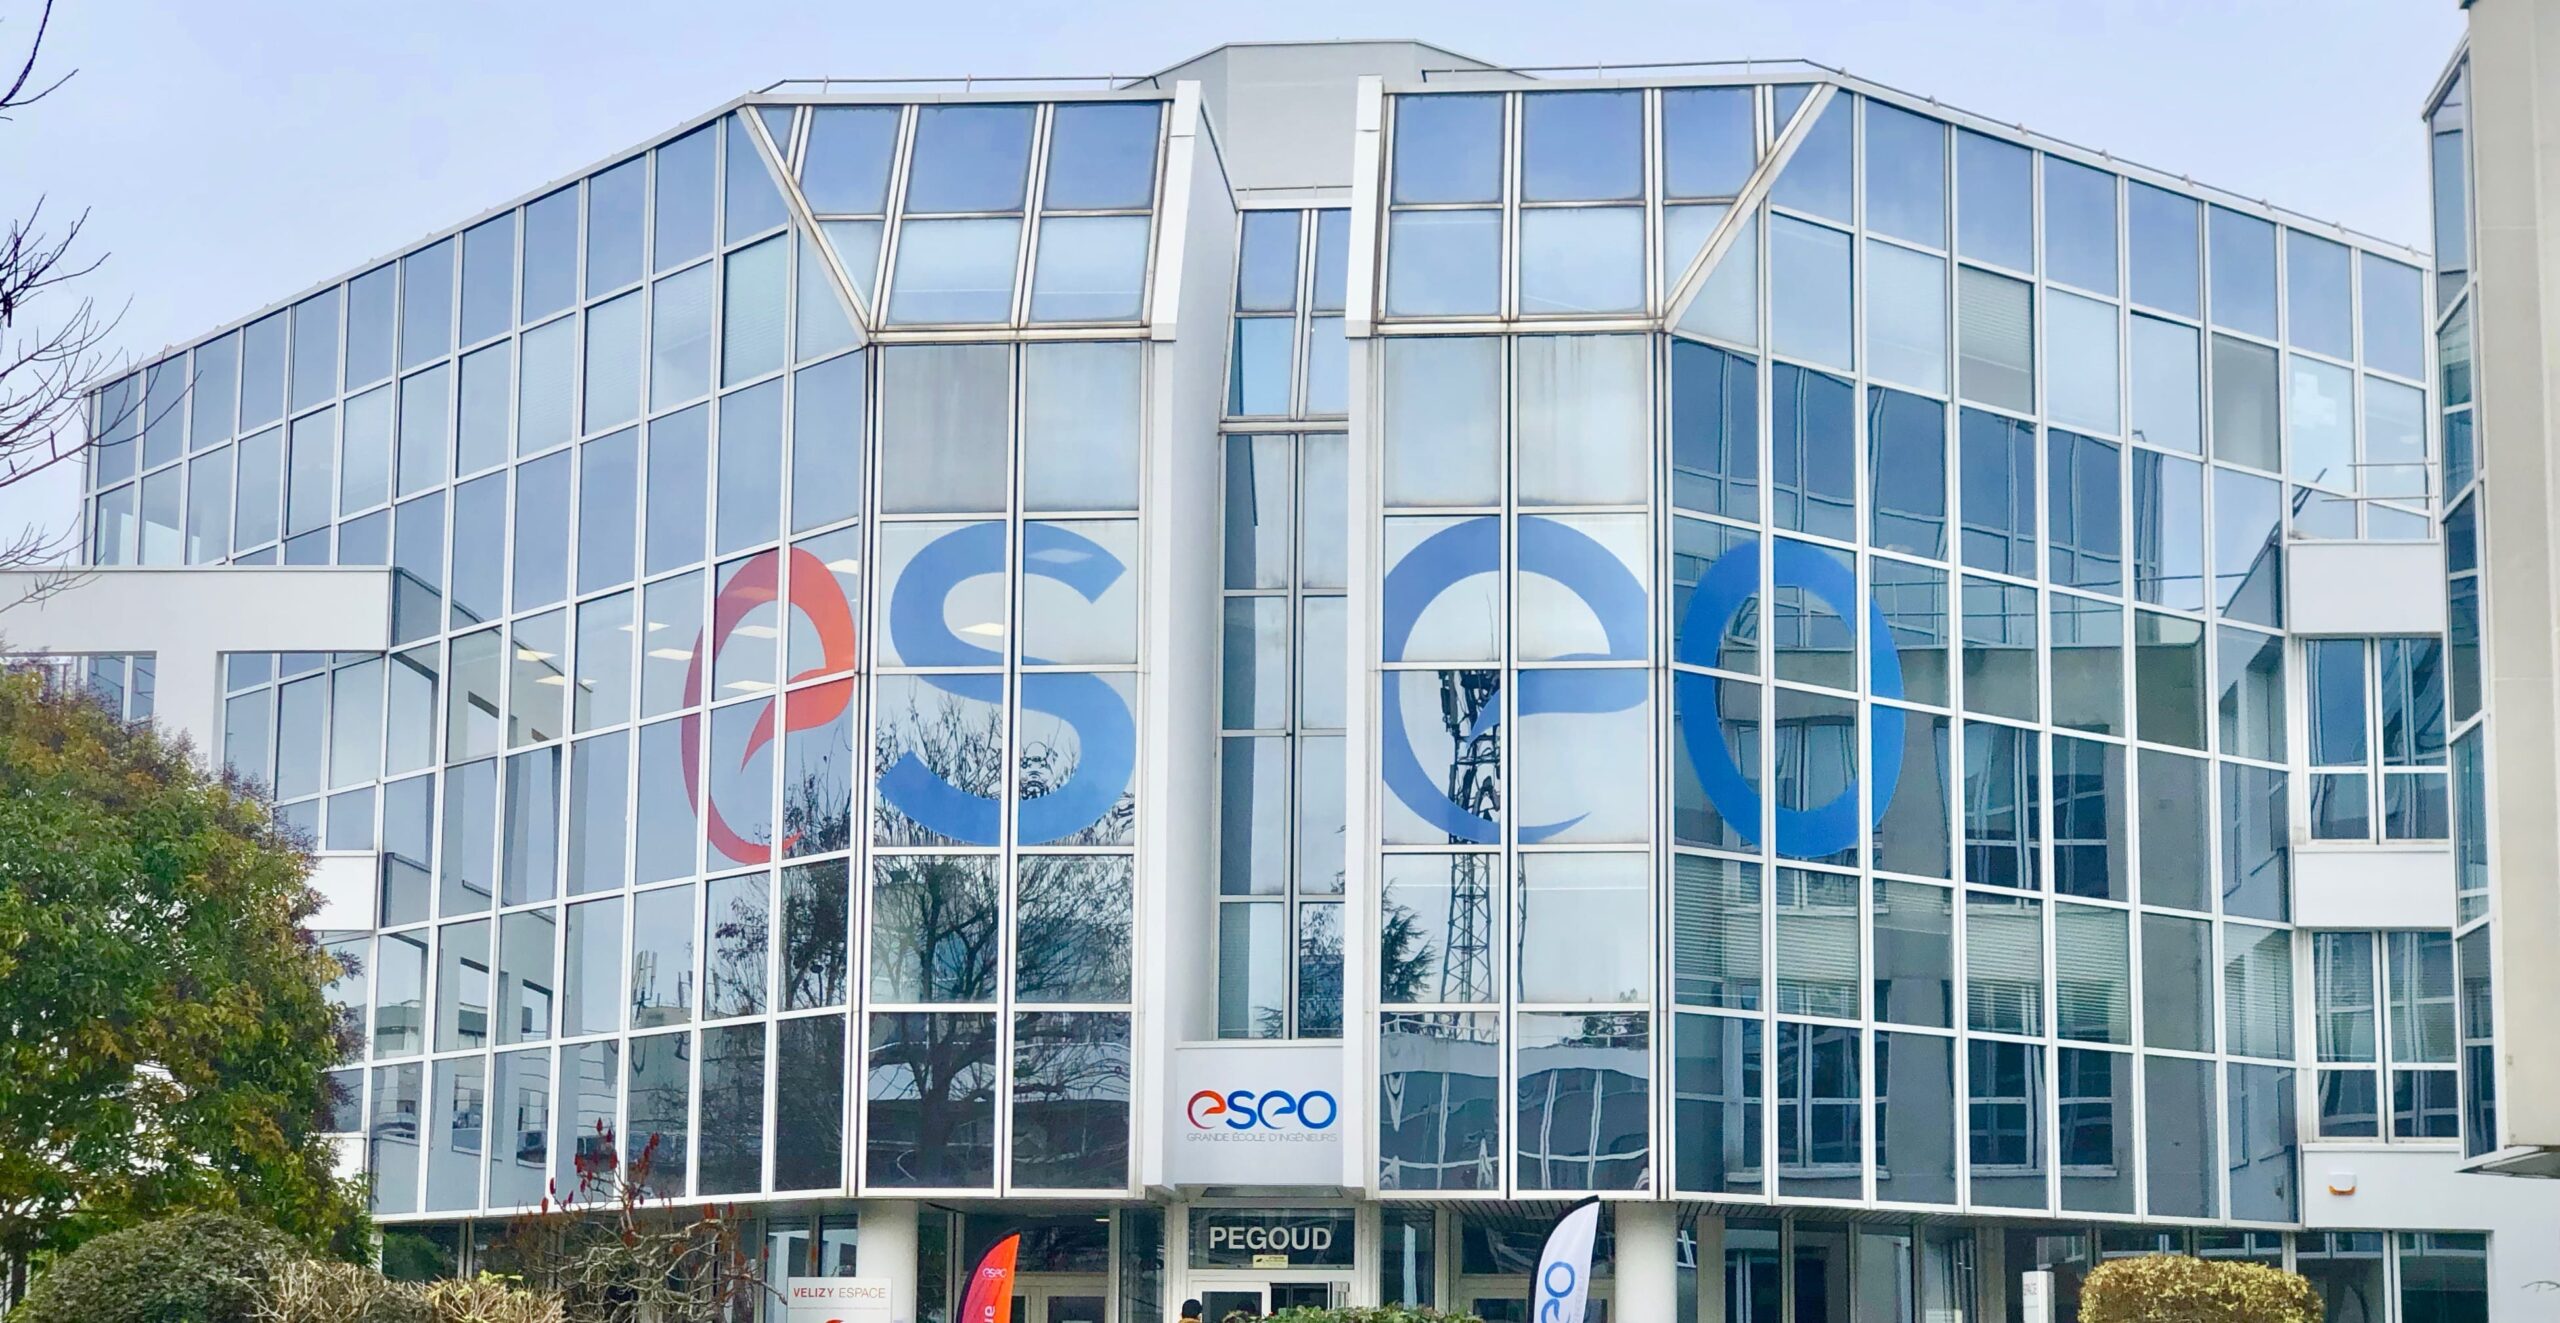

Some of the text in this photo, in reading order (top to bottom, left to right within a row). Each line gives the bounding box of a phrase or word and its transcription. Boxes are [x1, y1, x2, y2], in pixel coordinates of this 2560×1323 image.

[682, 516, 1905, 864] eseo
[1187, 1090, 1337, 1129] eseo
[1187, 1133, 1230, 1142] GRANDE
[1232, 1131, 1265, 1142] ÉCOLE
[1209, 1226, 1332, 1250] PEGOUD
[983, 1268, 1007, 1278] eseo
[793, 1287, 886, 1299] VELIZY ESPACE
